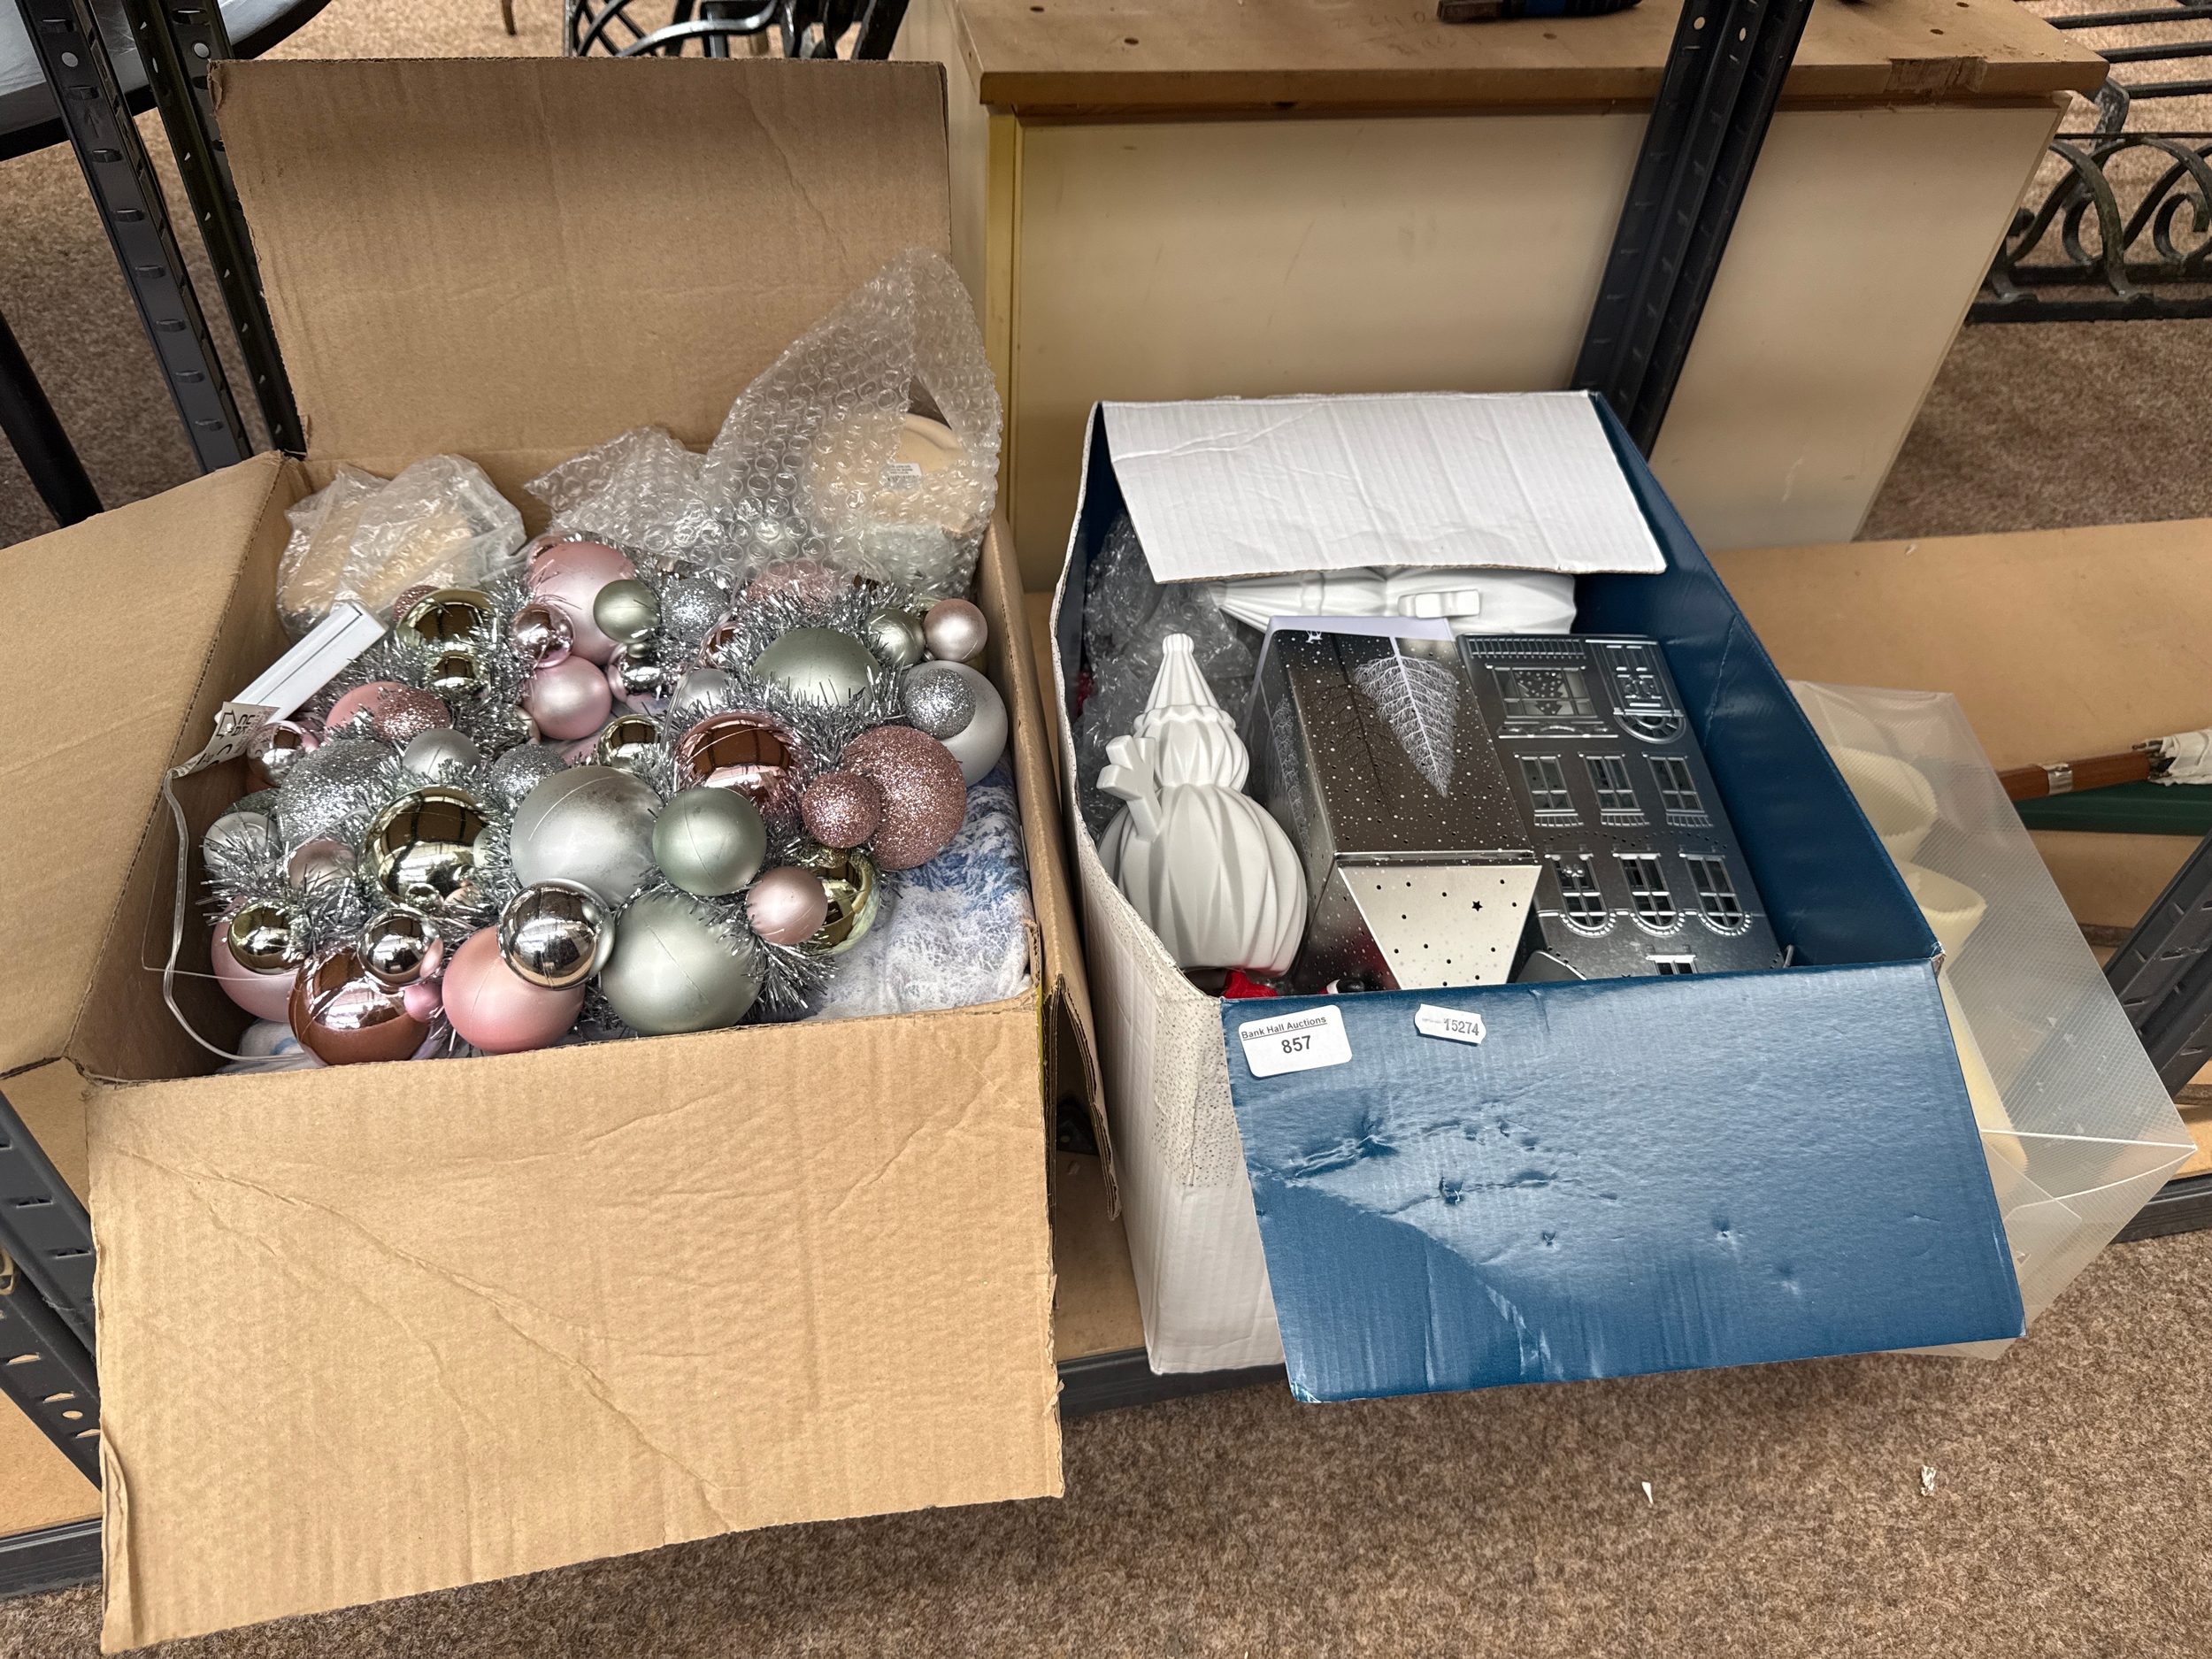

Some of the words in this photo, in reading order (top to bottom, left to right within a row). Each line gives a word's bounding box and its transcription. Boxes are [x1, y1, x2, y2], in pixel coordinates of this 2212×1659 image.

[1241, 1027, 1265, 1039] Bank
[1266, 1024, 1285, 1034] Hall
[1286, 1017, 1326, 1030] Auctions
[1443, 1018, 1479, 1036] 15274
[1281, 1035, 1311, 1054] 857
